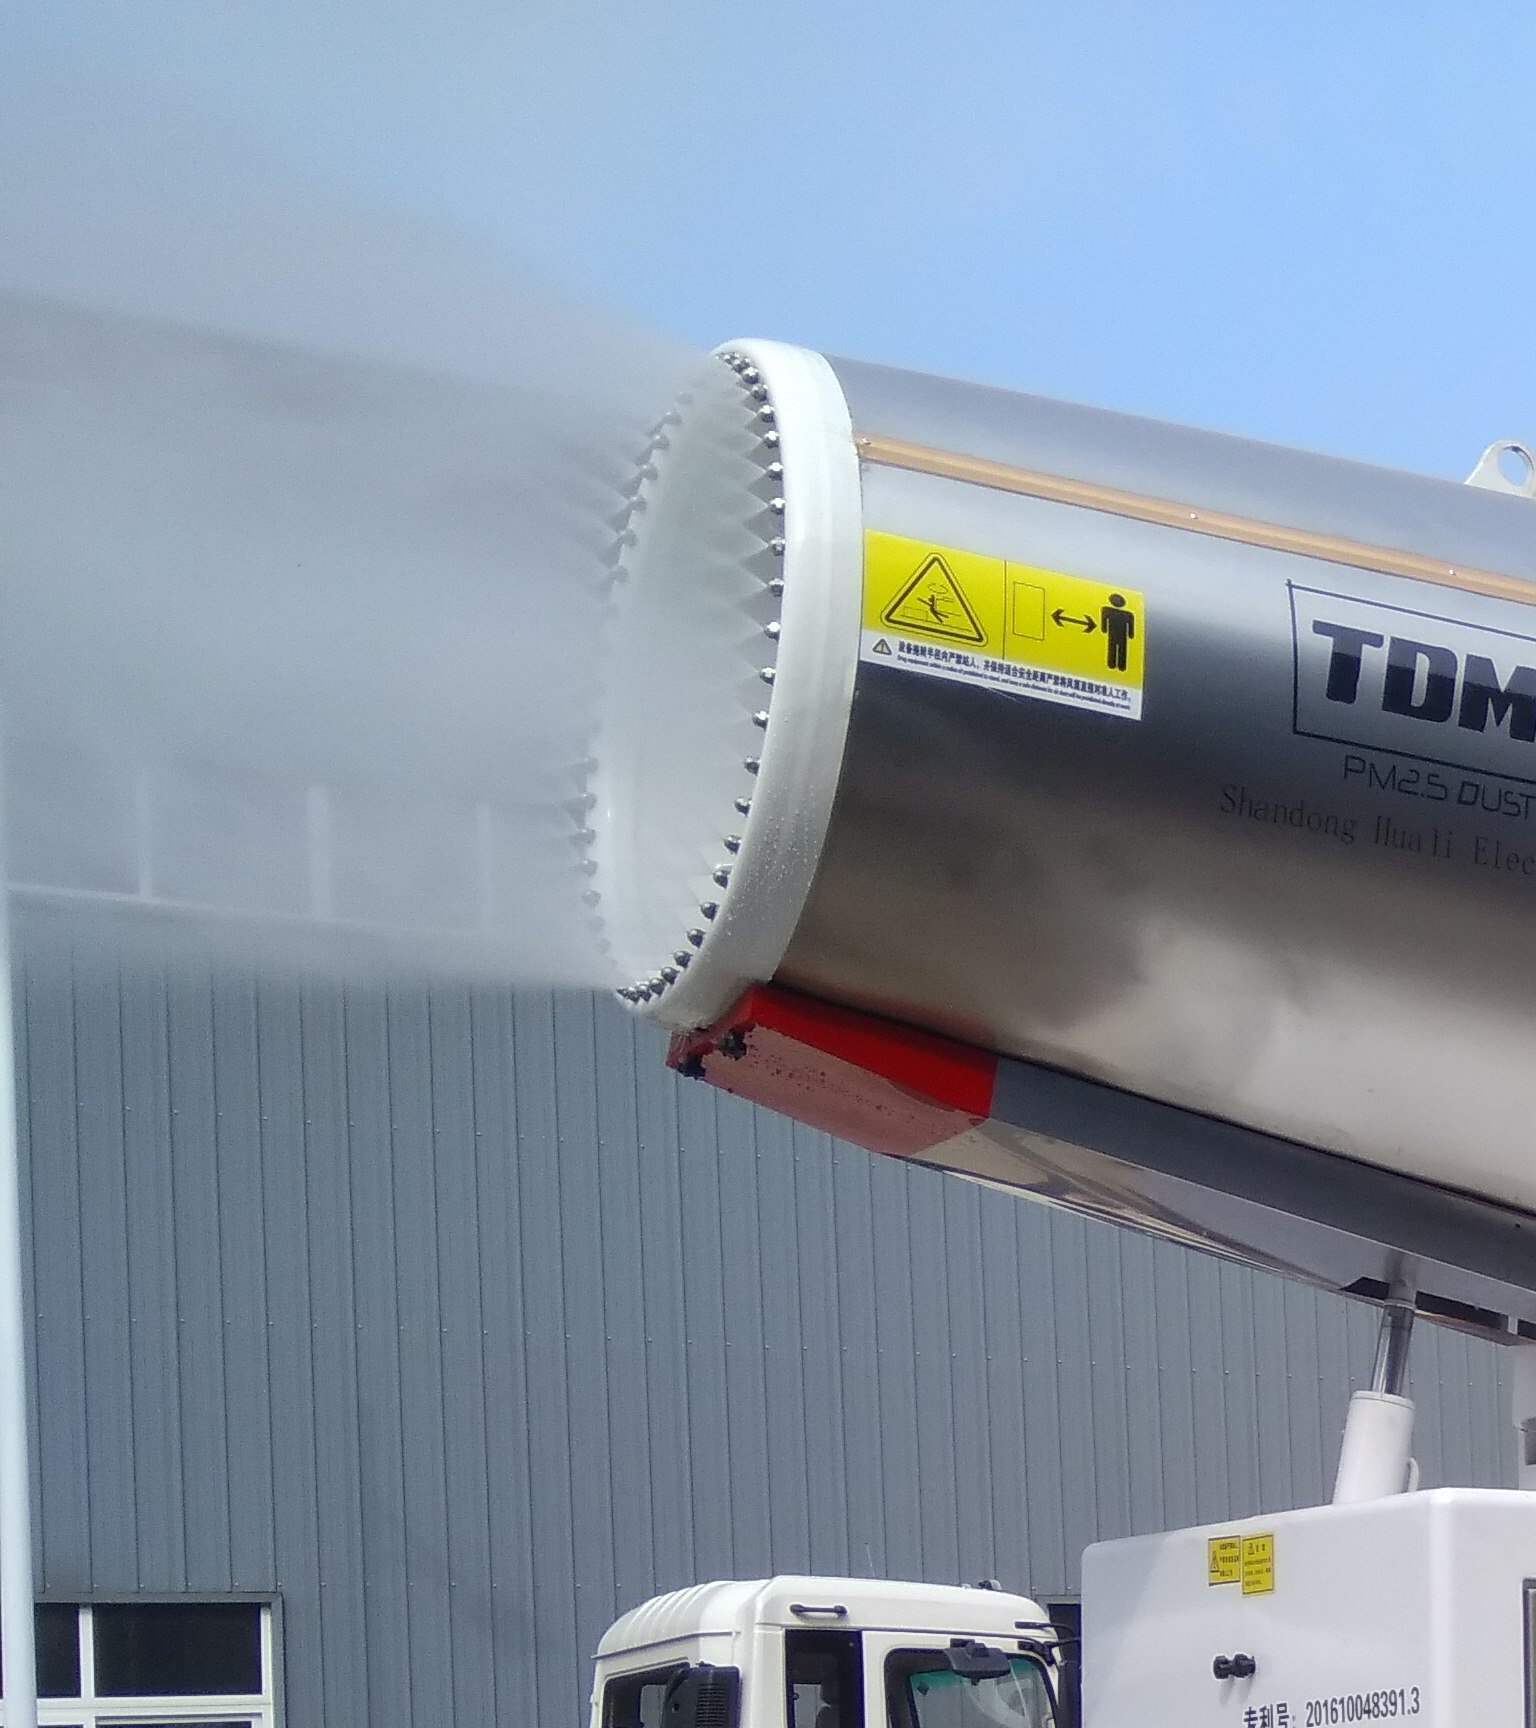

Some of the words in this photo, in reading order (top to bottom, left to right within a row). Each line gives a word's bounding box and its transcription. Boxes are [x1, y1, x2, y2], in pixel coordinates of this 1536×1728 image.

[1220, 783, 1355, 845] Shandong
[1343, 754, 1448, 801] PM2.5
[1457, 780, 1536, 820] DUST
[1305, 1686, 1421, 1728] 201610048391.3
